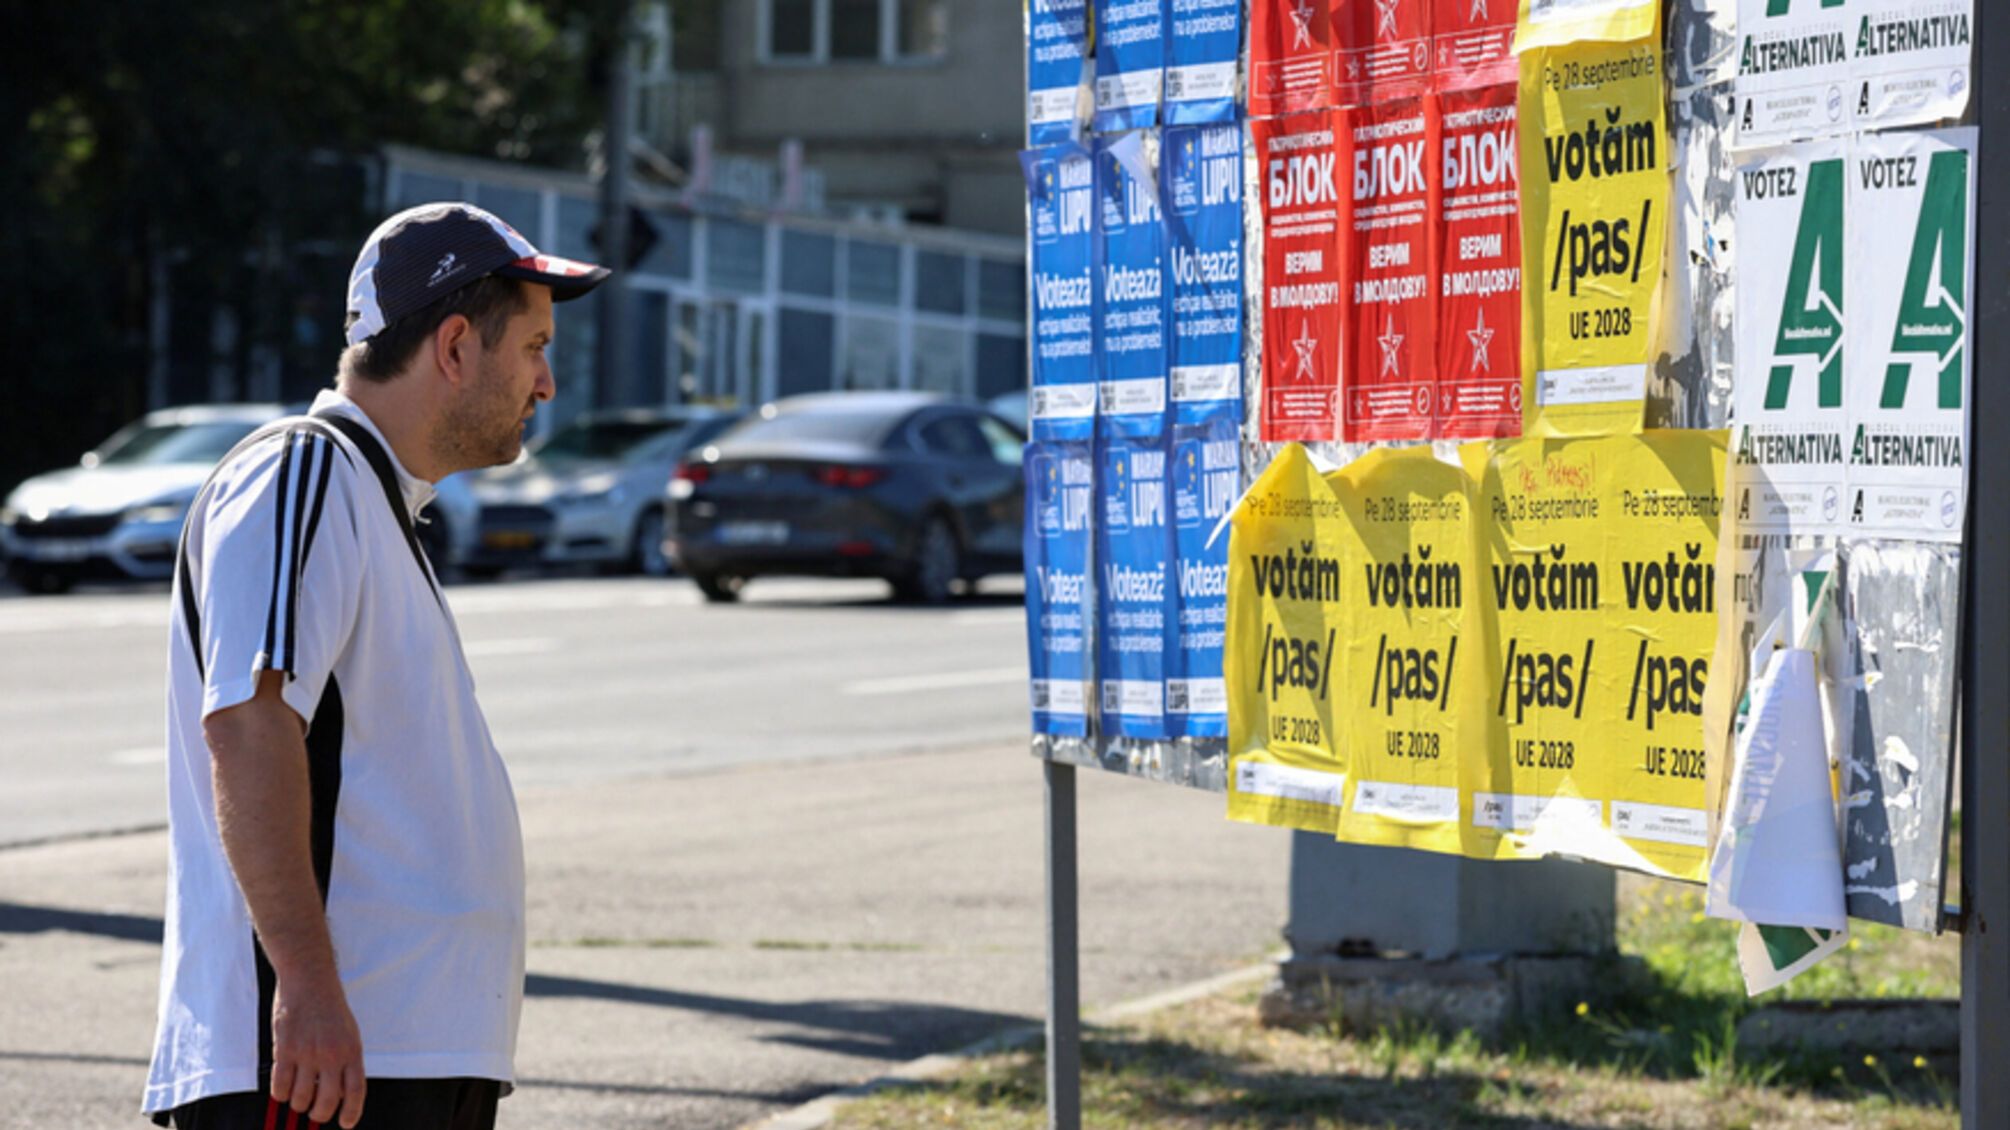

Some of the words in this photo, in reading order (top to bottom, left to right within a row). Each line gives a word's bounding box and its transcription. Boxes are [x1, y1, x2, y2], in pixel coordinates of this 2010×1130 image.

[1739, 31, 1846, 76] ALTERNATIVA
[1854, 14, 1970, 58] ALTERNATIVA
[1545, 67, 1560, 91] Pe
[1563, 61, 1579, 89] 28
[1582, 45, 1655, 90] septembrie
[1741, 98, 1753, 130] A
[1857, 80, 1869, 115] A
[1443, 129, 1517, 189] БЛОК
[1544, 106, 1656, 183] votăm
[1202, 156, 1238, 205] LUPU
[1269, 152, 1337, 208] БЛОК
[1354, 140, 1426, 200] БЛОК
[1743, 167, 1796, 200] VOTEZ
[1860, 157, 1917, 190] VOTEZ
[1172, 241, 1238, 285] Votează
[1285, 250, 1322, 275] ВЕРИМ
[1369, 242, 1409, 269] ВЕРИМ
[1460, 233, 1501, 260] ВЕРИМ
[1551, 199, 1651, 297] /pas/
[1271, 286, 1277, 308] В
[1278, 281, 1338, 309] МОЛДОВУ!
[1355, 282, 1361, 305] В
[1362, 274, 1426, 305] МОЛДОВУ!
[1443, 274, 1450, 297] В
[1451, 268, 1520, 298] МОЛДОВУ!
[1570, 311, 1589, 340] UE
[1594, 307, 1632, 338] 2028
[1736, 425, 1843, 465] ALTERNATIVA
[1850, 424, 1962, 467] ALTERNATIVA
[1132, 481, 1165, 527] LUPU
[1365, 498, 1379, 521] Pe
[1381, 498, 1396, 522] 28
[1398, 494, 1461, 526] septembrie
[1492, 496, 1508, 522] Pe
[1511, 496, 1525, 521] 28
[1529, 491, 1599, 524] septembrie
[1623, 490, 1639, 516] Pe
[1643, 490, 1660, 517] 28
[1739, 488, 1750, 519] A
[1851, 489, 1864, 522] A
[1176, 558, 1228, 598] Voteaz
[1251, 540, 1340, 602] votăm
[1366, 544, 1461, 608] votăm
[1493, 543, 1598, 611] votăm
[1257, 623, 1336, 702] /pas/
[1371, 634, 1457, 716] /pas/
[1498, 638, 1594, 725] /pas/
[1627, 639, 1708, 730] /pas
[1273, 716, 1287, 742] UE
[1291, 718, 1320, 746] 2028
[1387, 730, 1403, 756] UE
[1407, 731, 1440, 760] 2028
[1517, 739, 1534, 767] UE
[1538, 740, 1575, 769] 2028
[1647, 746, 1665, 776] UE
